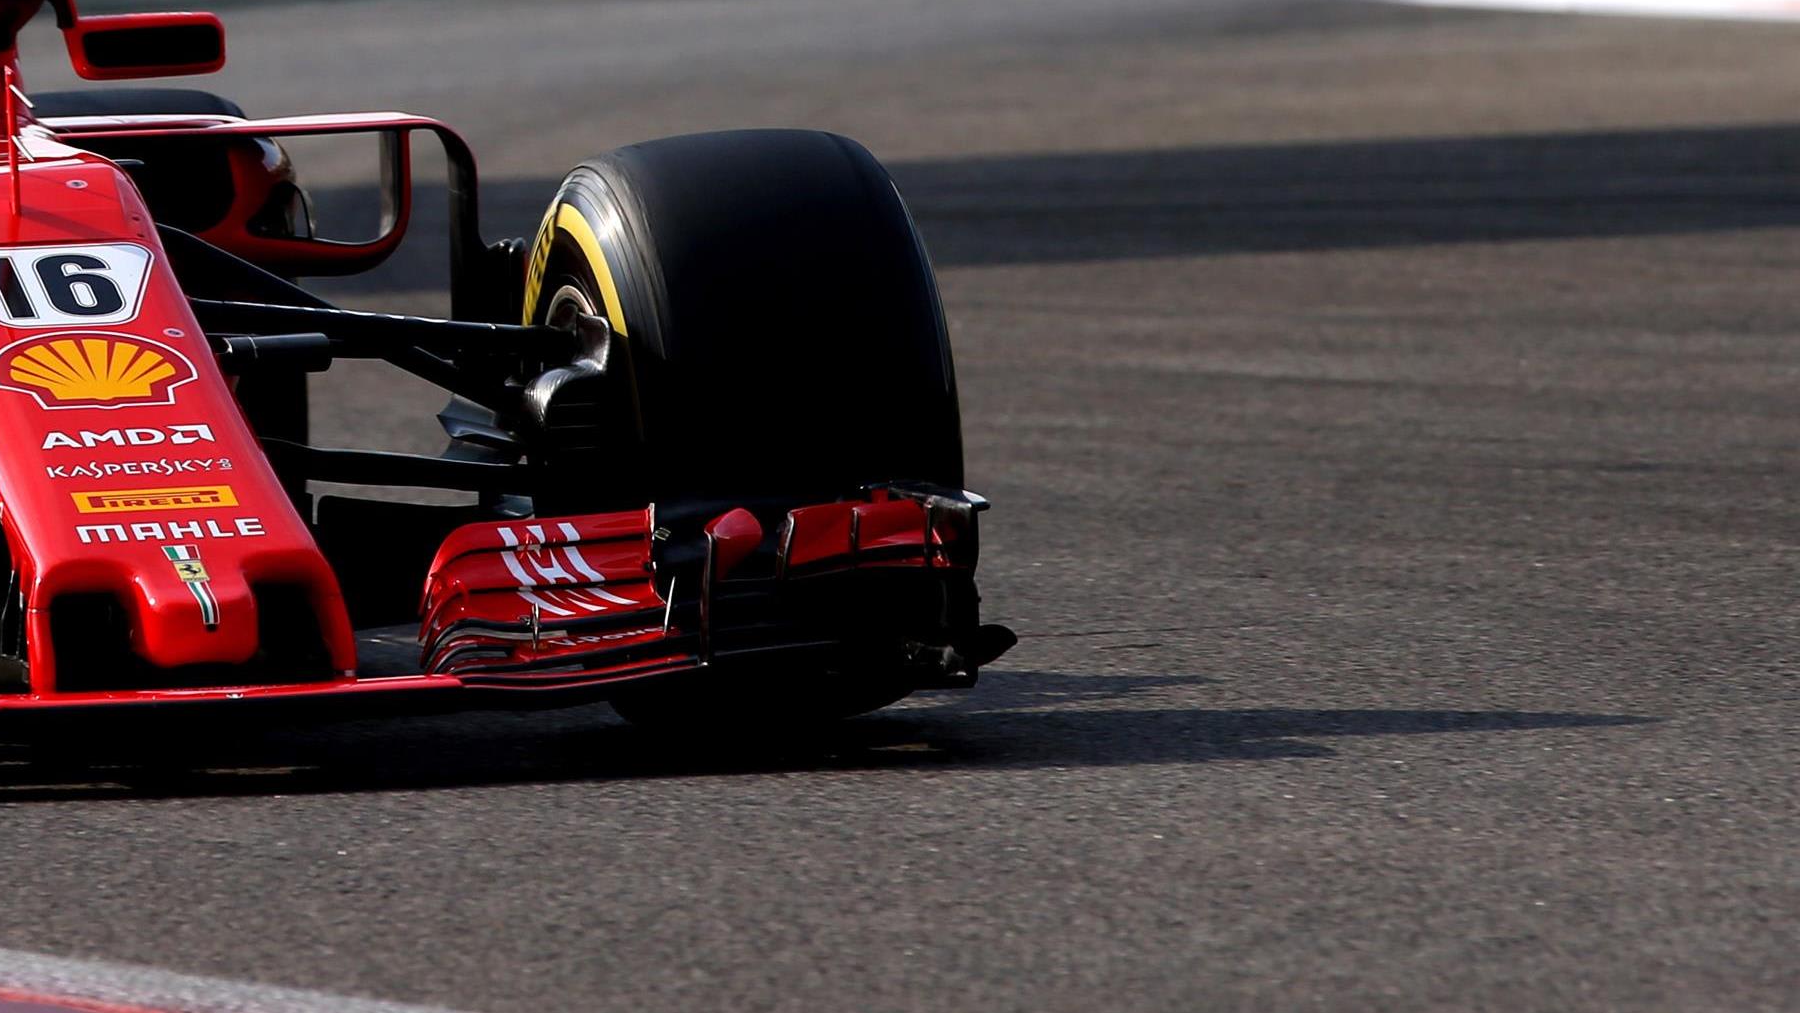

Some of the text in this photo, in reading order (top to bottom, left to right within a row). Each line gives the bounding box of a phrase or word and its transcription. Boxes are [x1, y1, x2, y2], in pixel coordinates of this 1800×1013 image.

[42, 427, 166, 449] AMD
[46, 458, 213, 479] KASPERSKY
[87, 490, 220, 508] PIRELLI
[75, 517, 266, 544] MAHLE
